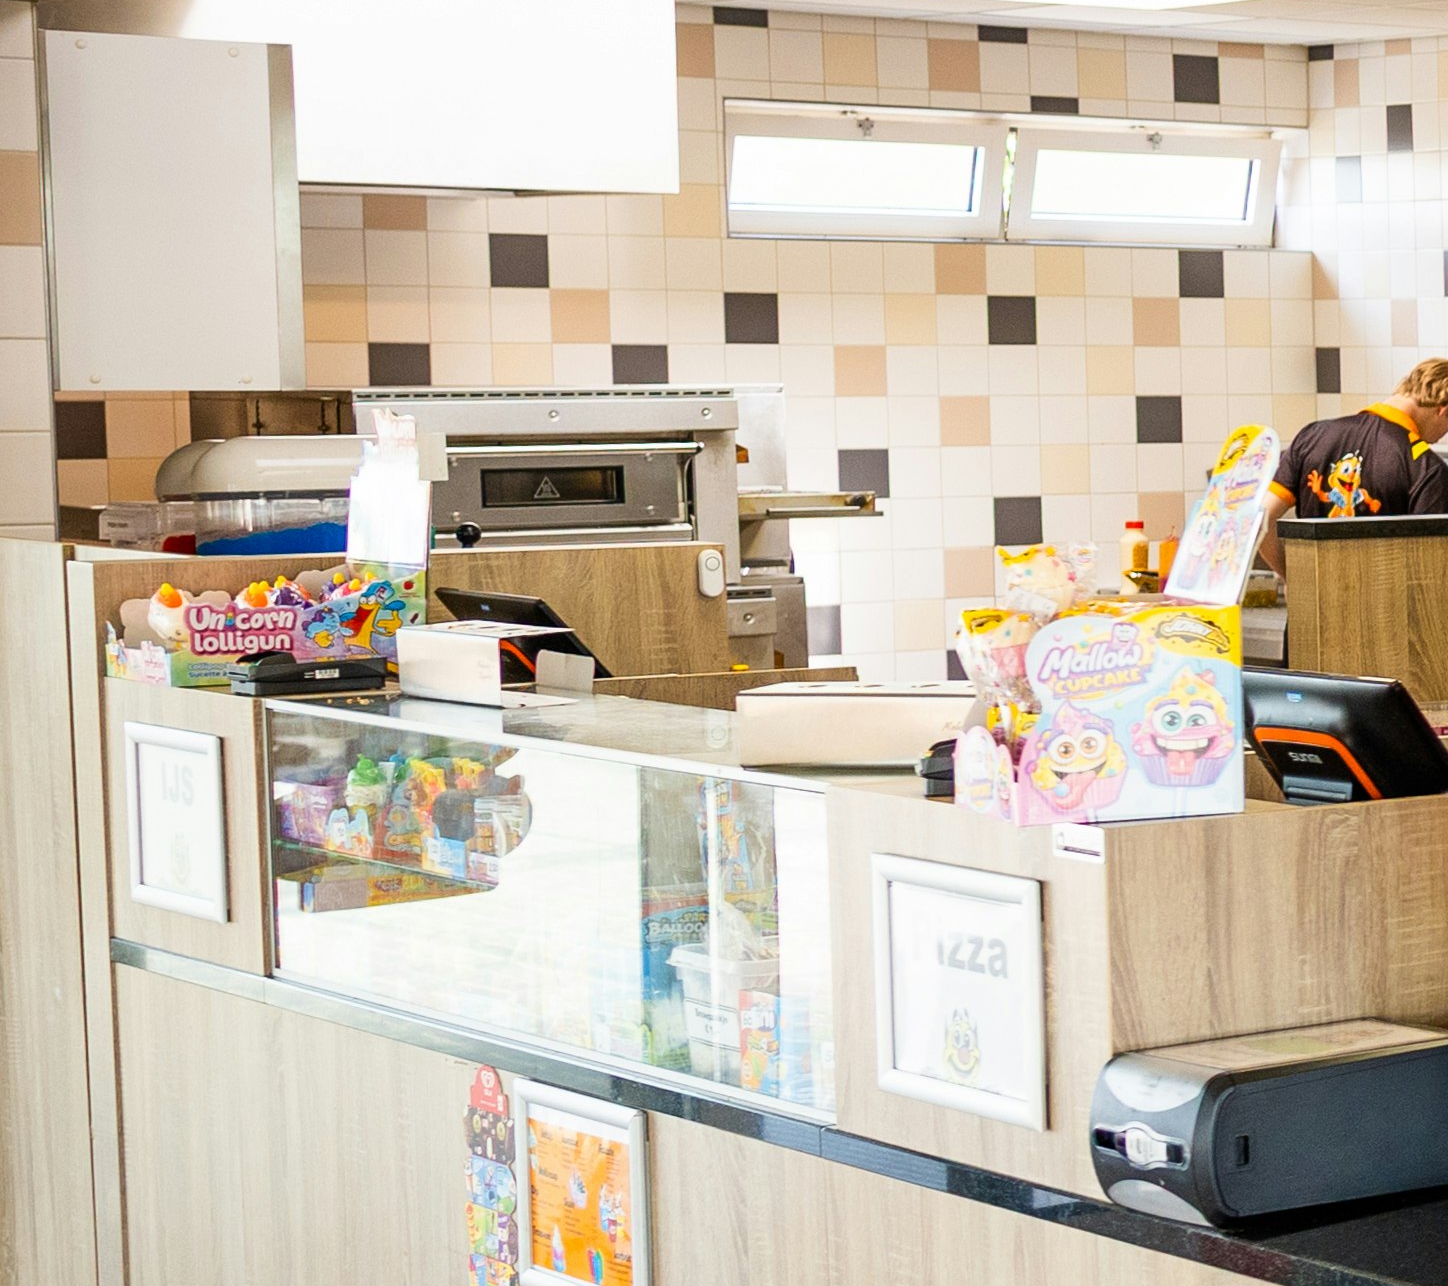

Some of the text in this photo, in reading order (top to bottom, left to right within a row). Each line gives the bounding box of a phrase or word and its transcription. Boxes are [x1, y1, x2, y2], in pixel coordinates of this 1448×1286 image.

[188, 608, 296, 632] Unicorn
[1039, 644, 1143, 680] Mallow
[1052, 668, 1146, 696] CUPCAKE
[160, 760, 195, 807] IJS
